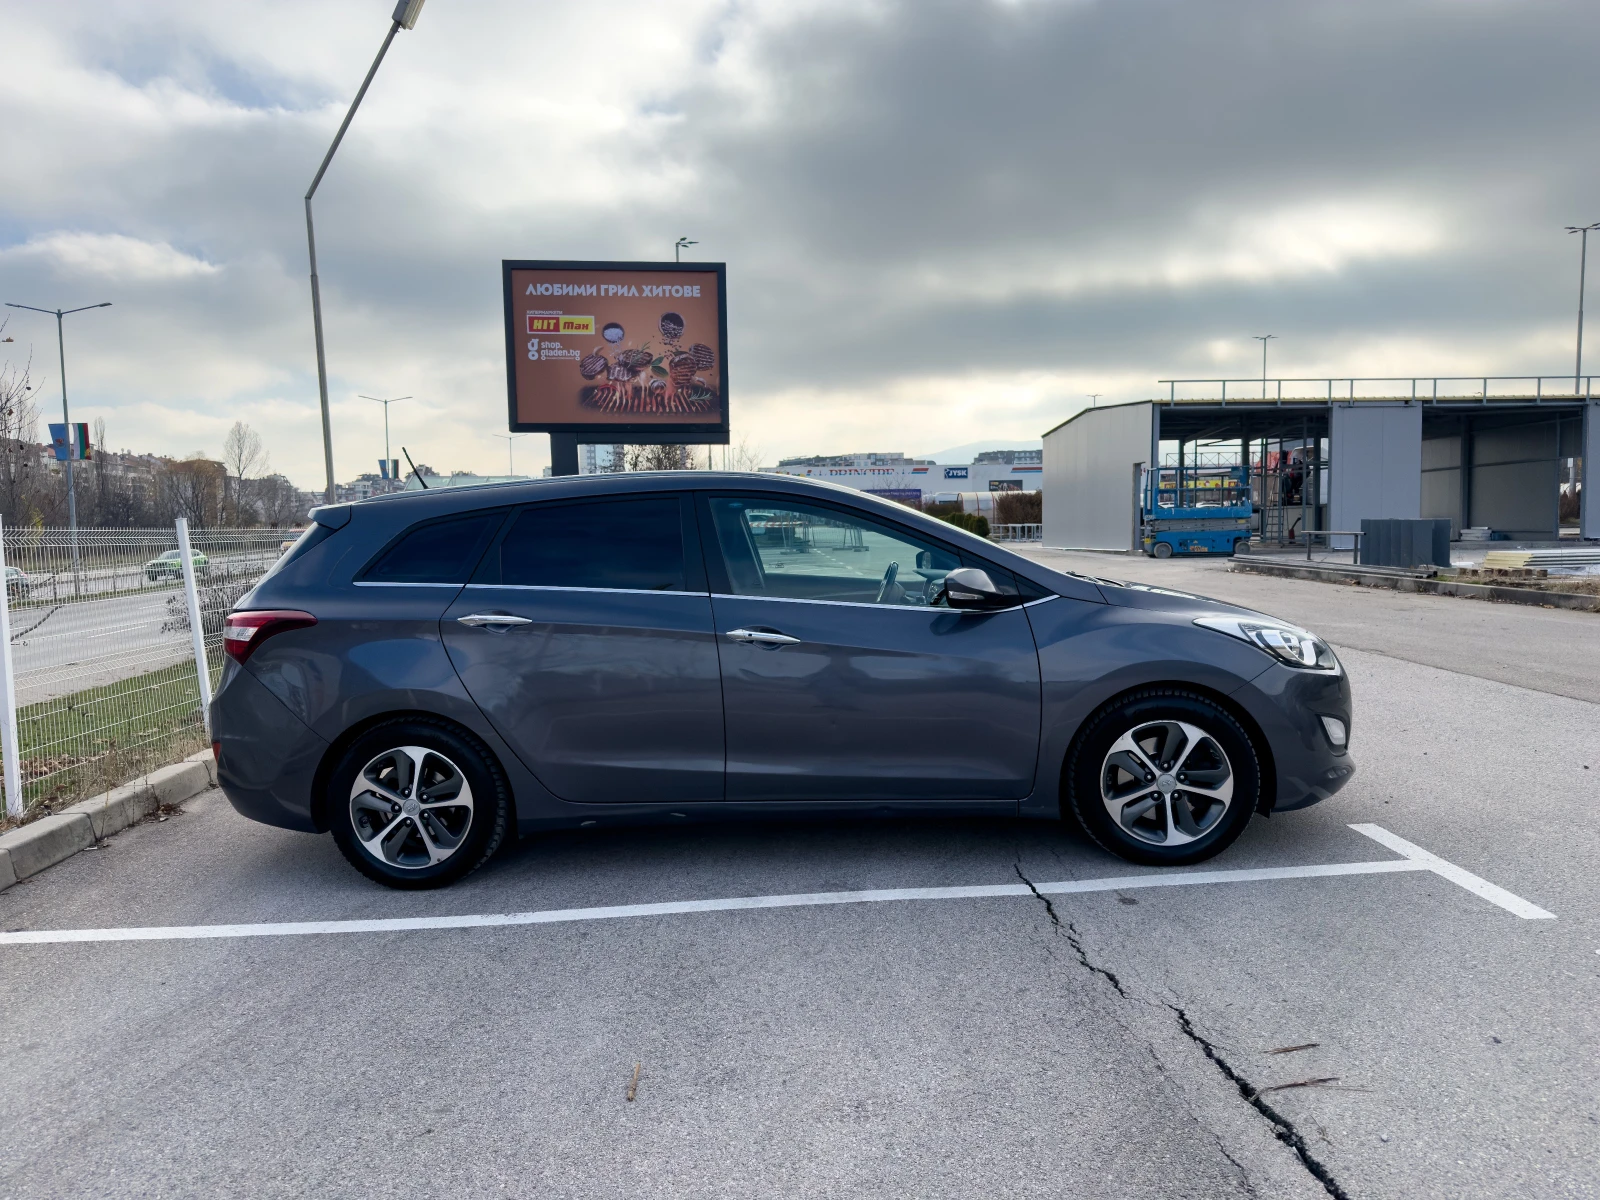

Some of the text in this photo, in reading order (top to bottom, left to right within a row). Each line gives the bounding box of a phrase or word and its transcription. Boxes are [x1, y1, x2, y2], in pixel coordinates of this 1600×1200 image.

[526, 283, 701, 298] ЛЮБИМИ ГРИЛ ХИТОВЕ
[533, 319, 557, 330] HIT
[540, 341, 563, 350] shop.
[948, 469, 967, 477] JYSK
